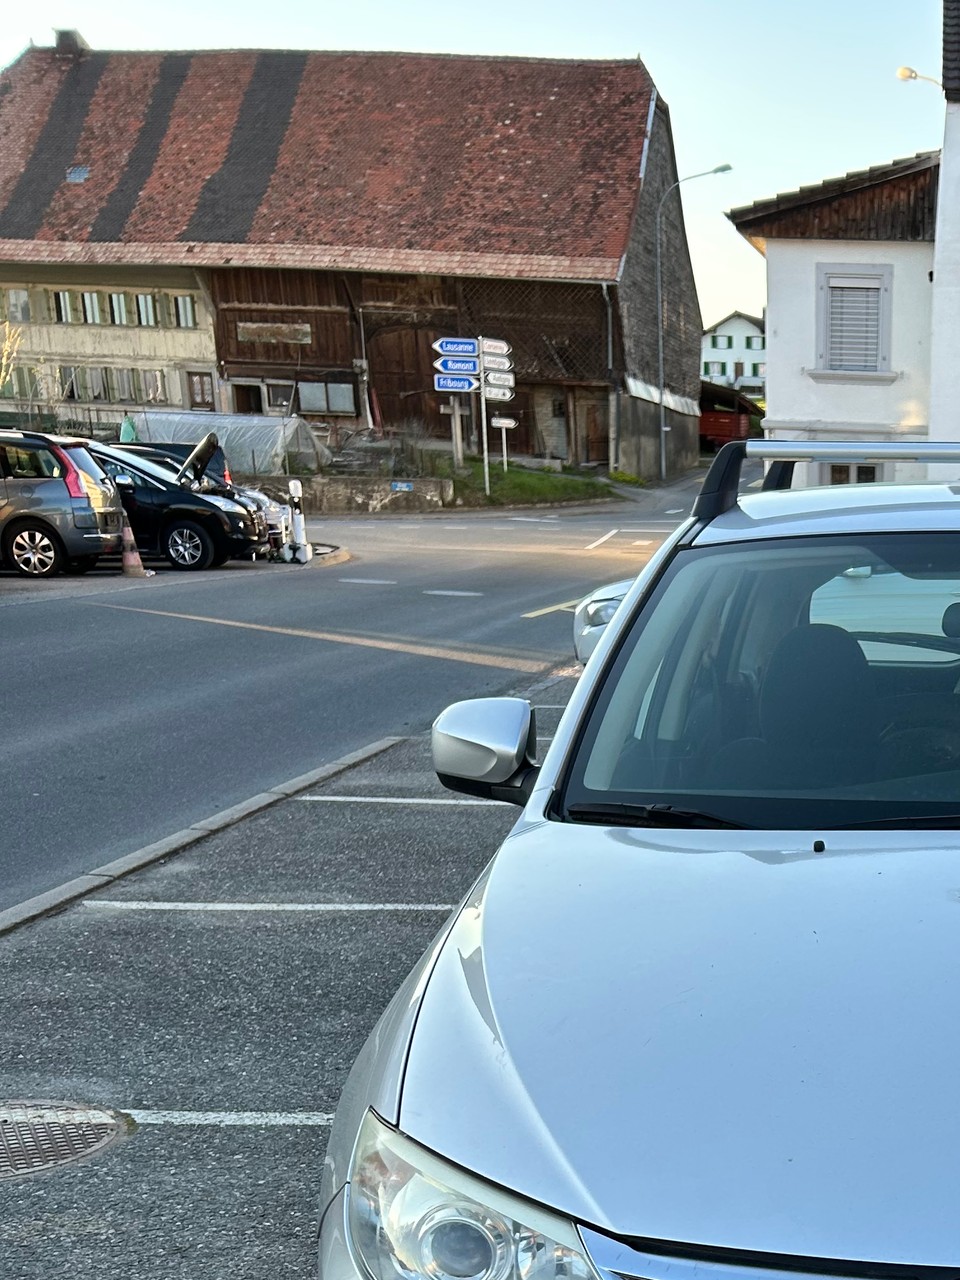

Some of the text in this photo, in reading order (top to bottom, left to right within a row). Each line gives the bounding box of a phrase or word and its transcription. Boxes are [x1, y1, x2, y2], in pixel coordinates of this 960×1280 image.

[442, 341, 474, 352] Lausanne
[447, 360, 474, 370] Romont
[440, 378, 469, 388] Fribourg
